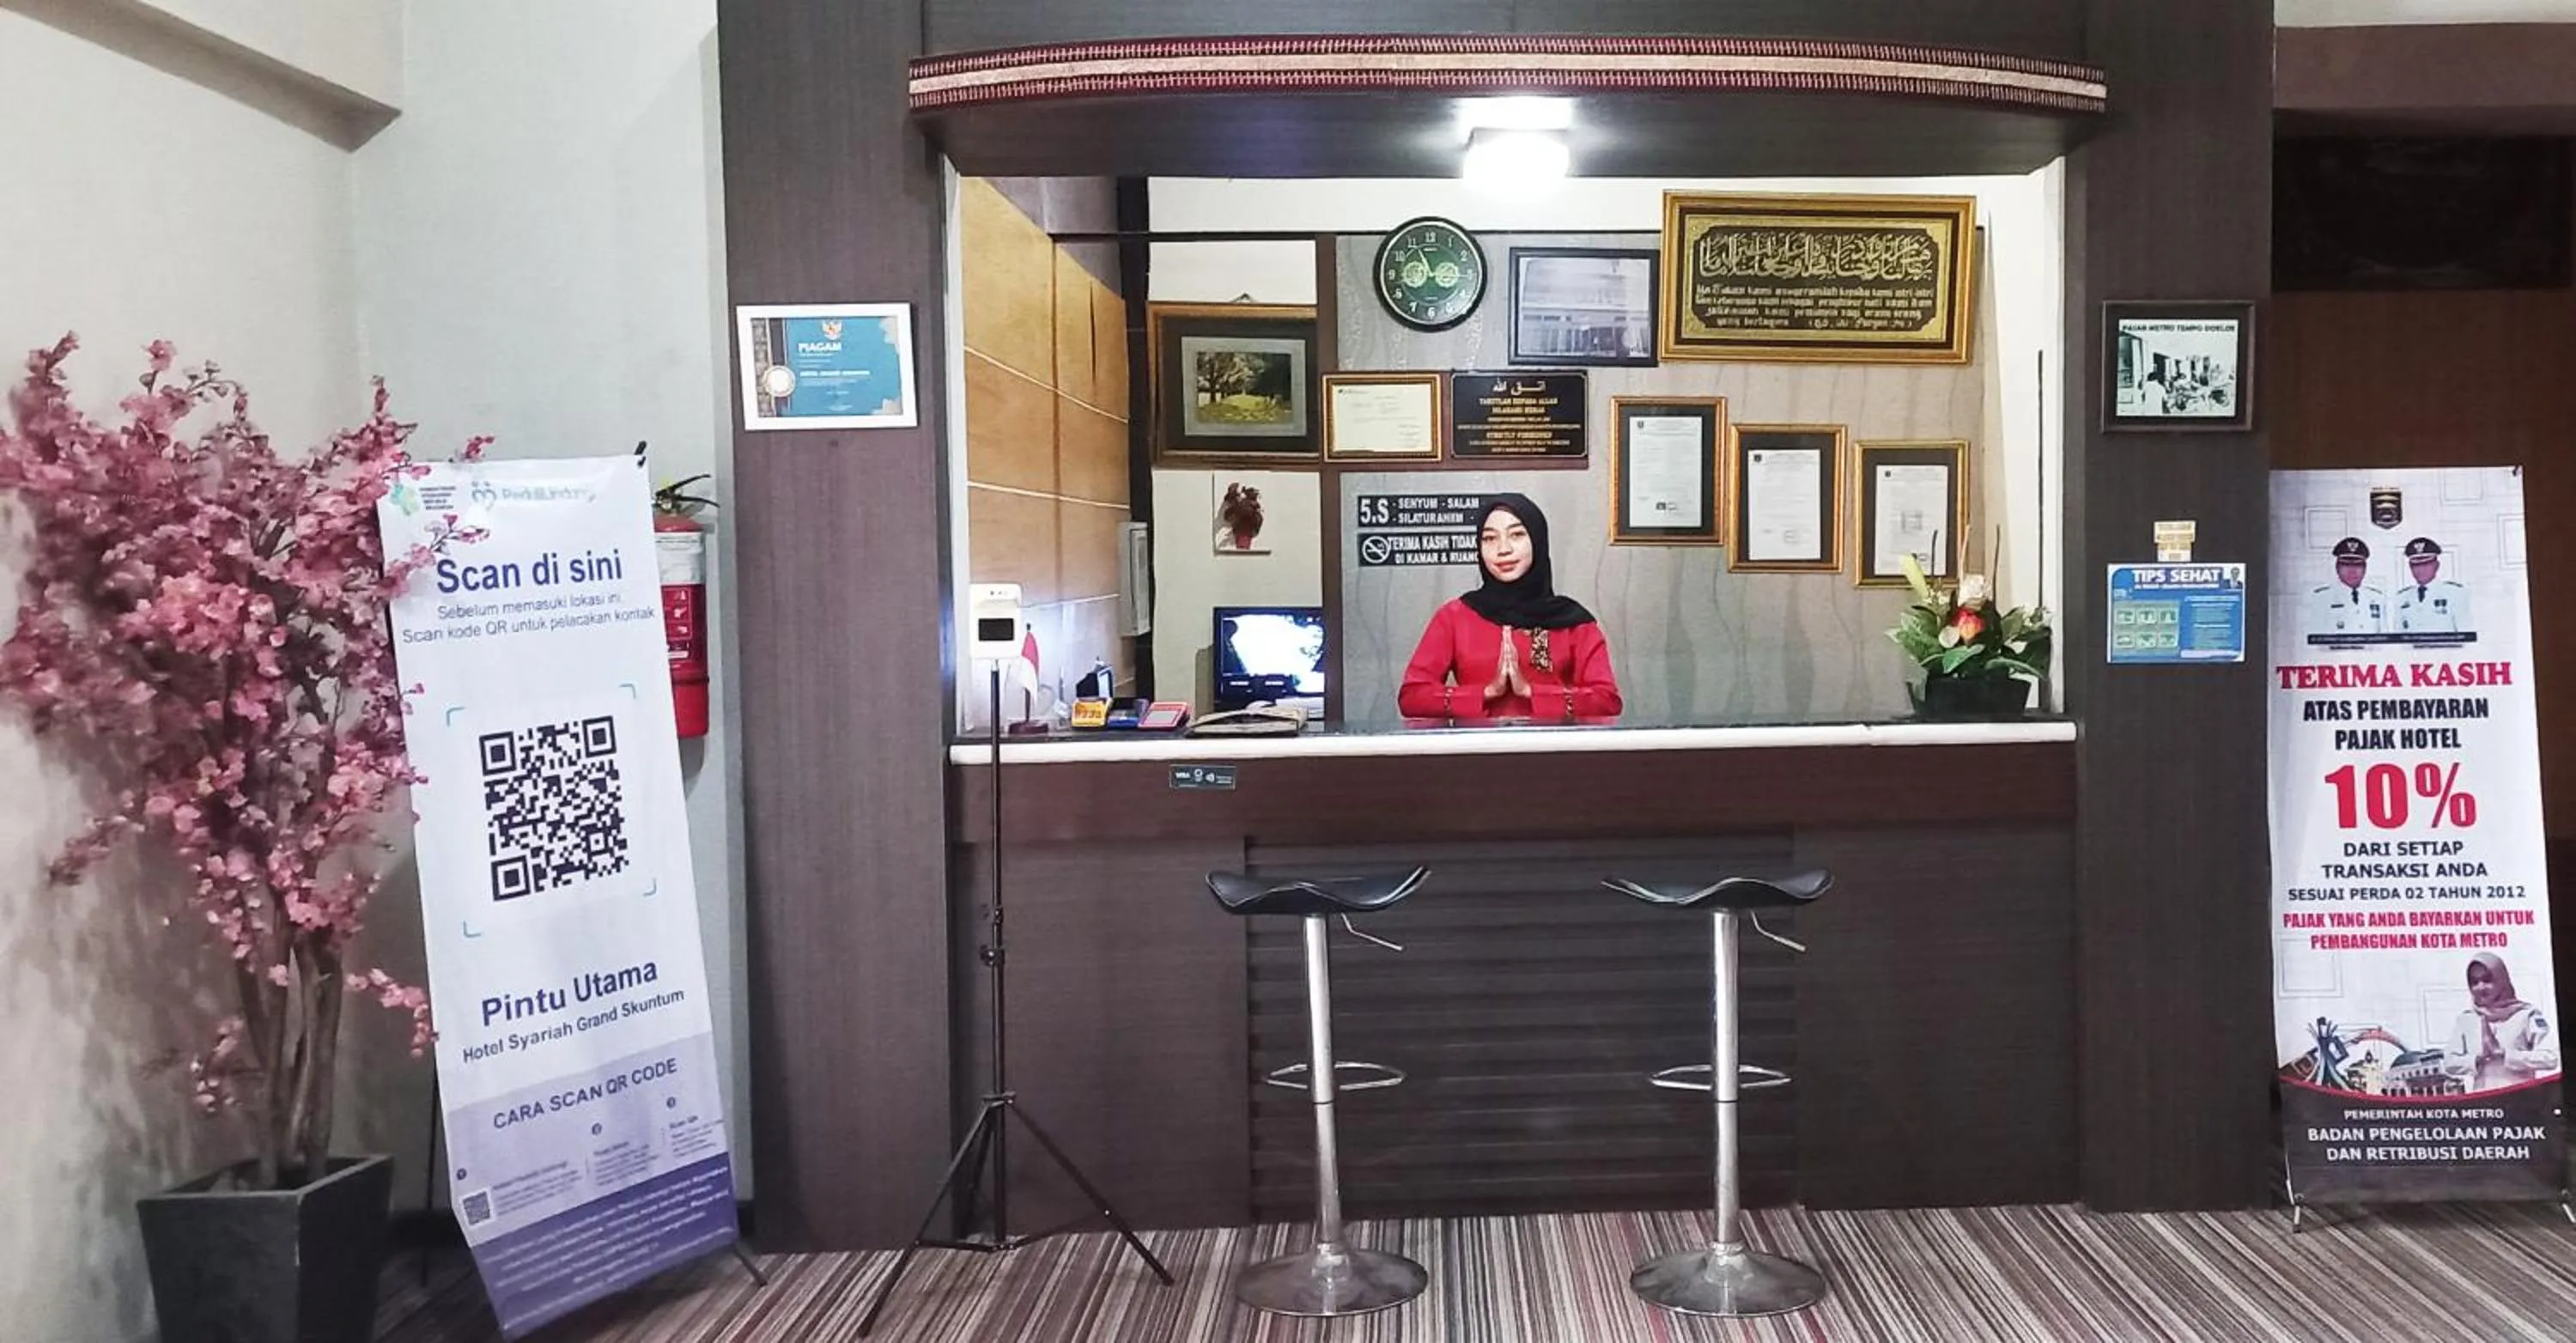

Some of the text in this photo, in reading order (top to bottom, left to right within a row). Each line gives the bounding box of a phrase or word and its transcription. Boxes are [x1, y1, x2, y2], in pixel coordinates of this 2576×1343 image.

[1398, 497, 1479, 509] SENYUM SALAM
[1388, 535, 1477, 550] TERIMA KASIH TIDAK
[1406, 551, 1438, 563] KAMAR
[436, 549, 622, 593] Scan di sini
[2130, 568, 2222, 583] TIPS SEHAT
[438, 593, 623, 621] Sebelum memasuki lokasi ini
[403, 605, 655, 644] Scan kode QR untuk pelacakan kontak
[2276, 662, 2512, 690] TERIMA KASIH
[2303, 698, 2489, 721] ATAS PEMBAYARAN
[2335, 728, 2462, 750] PAJAK HOTEL
[2324, 762, 2476, 829] 10%
[2343, 841, 2464, 858] DARI SETIAP
[2322, 862, 2488, 878] TRANSAKSI ANDA
[2288, 885, 2525, 901] SESUAI PERDA 02 TAHUN 2012
[2283, 909, 2535, 928] PAJAK YANG ANDA BAYARKAN UNTUK
[2311, 932, 2508, 950] PEMBANGUNAN KOTA METRO
[482, 961, 659, 1027] Pintu Utama
[463, 989, 685, 1063] Hotel Syariah Grand Skuntum
[493, 1057, 678, 1129] CARA SCAN QR CODE
[2344, 1109, 2505, 1120] PEMERINTAH KOTA METRO
[2308, 1126, 2546, 1142] BADAN PENGELOLAAN PAJAK
[2326, 1146, 2530, 1161] DAN RETRIBUSI DAERAH
